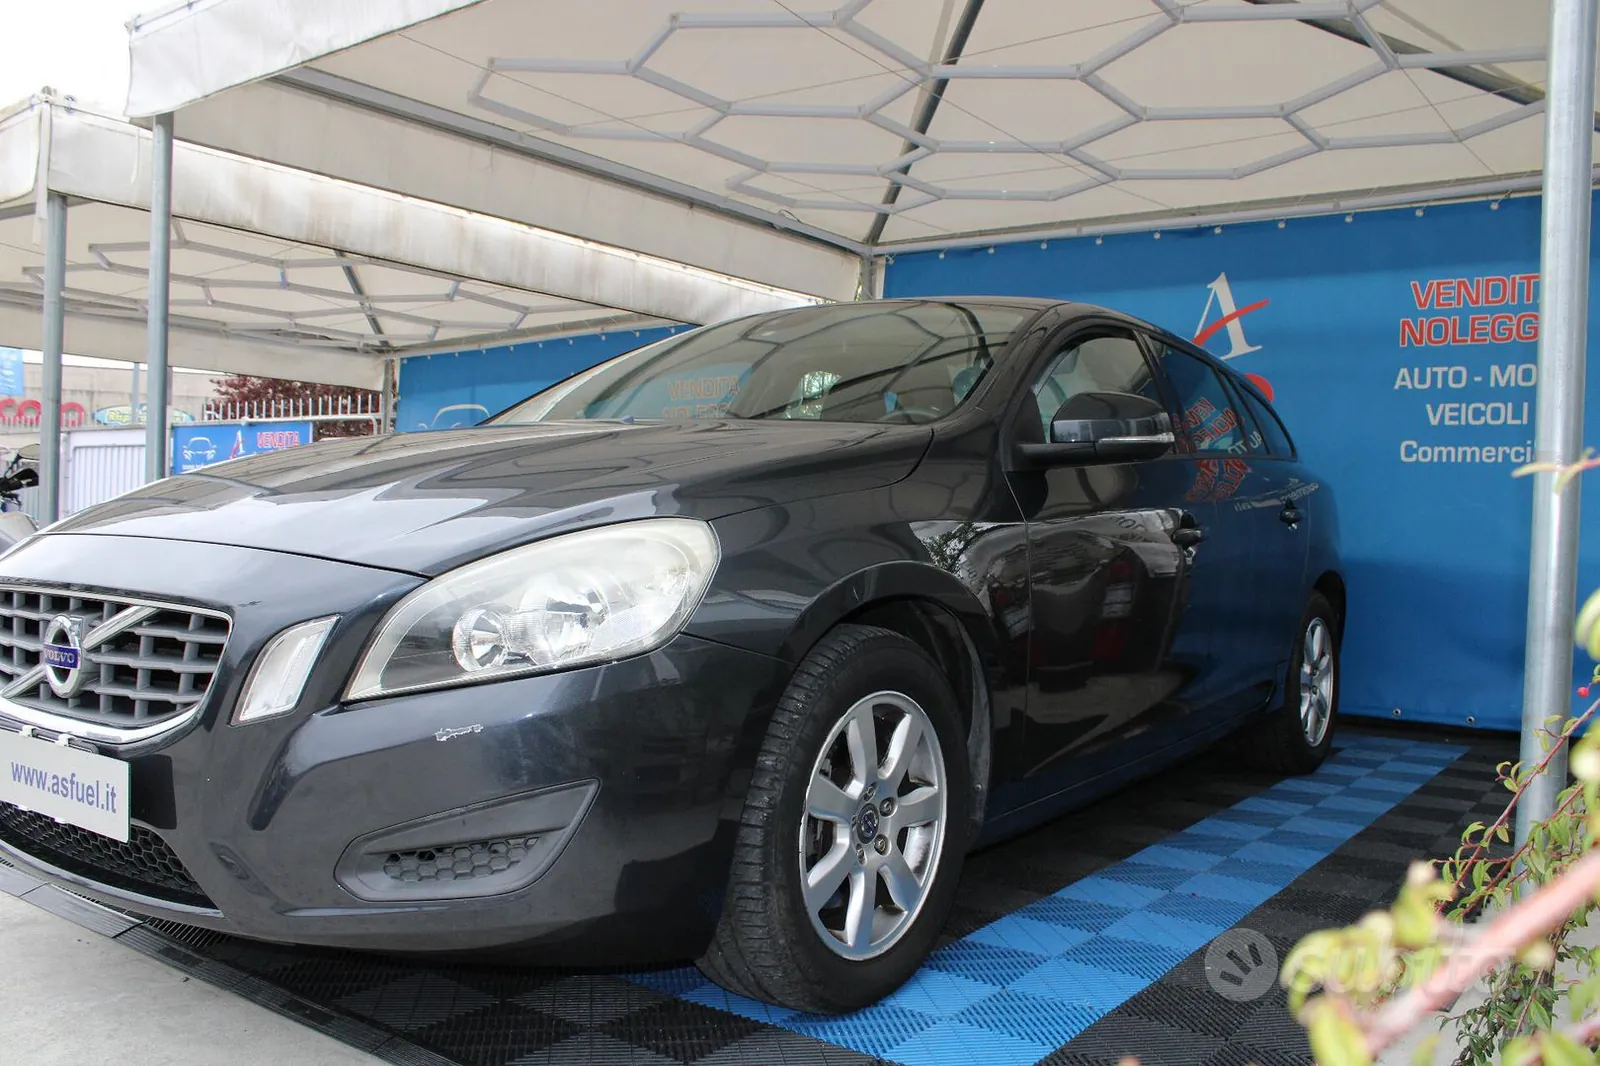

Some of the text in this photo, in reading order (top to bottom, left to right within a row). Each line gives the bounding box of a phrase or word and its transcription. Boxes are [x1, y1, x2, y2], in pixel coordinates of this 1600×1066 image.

[1410, 273, 1540, 310] VENDIT
[1400, 311, 1540, 347] NOLEGG
[667, 376, 740, 402] VENDITA
[1393, 365, 1468, 390] AUTO
[1489, 363, 1538, 388] MO
[1425, 402, 1529, 426] VEICOLI
[256, 431, 300, 449] VENDITA
[1400, 440, 1536, 464] Commerci
[44, 649, 75, 664] VOLVO
[11, 761, 117, 814] www.asfuel.it
